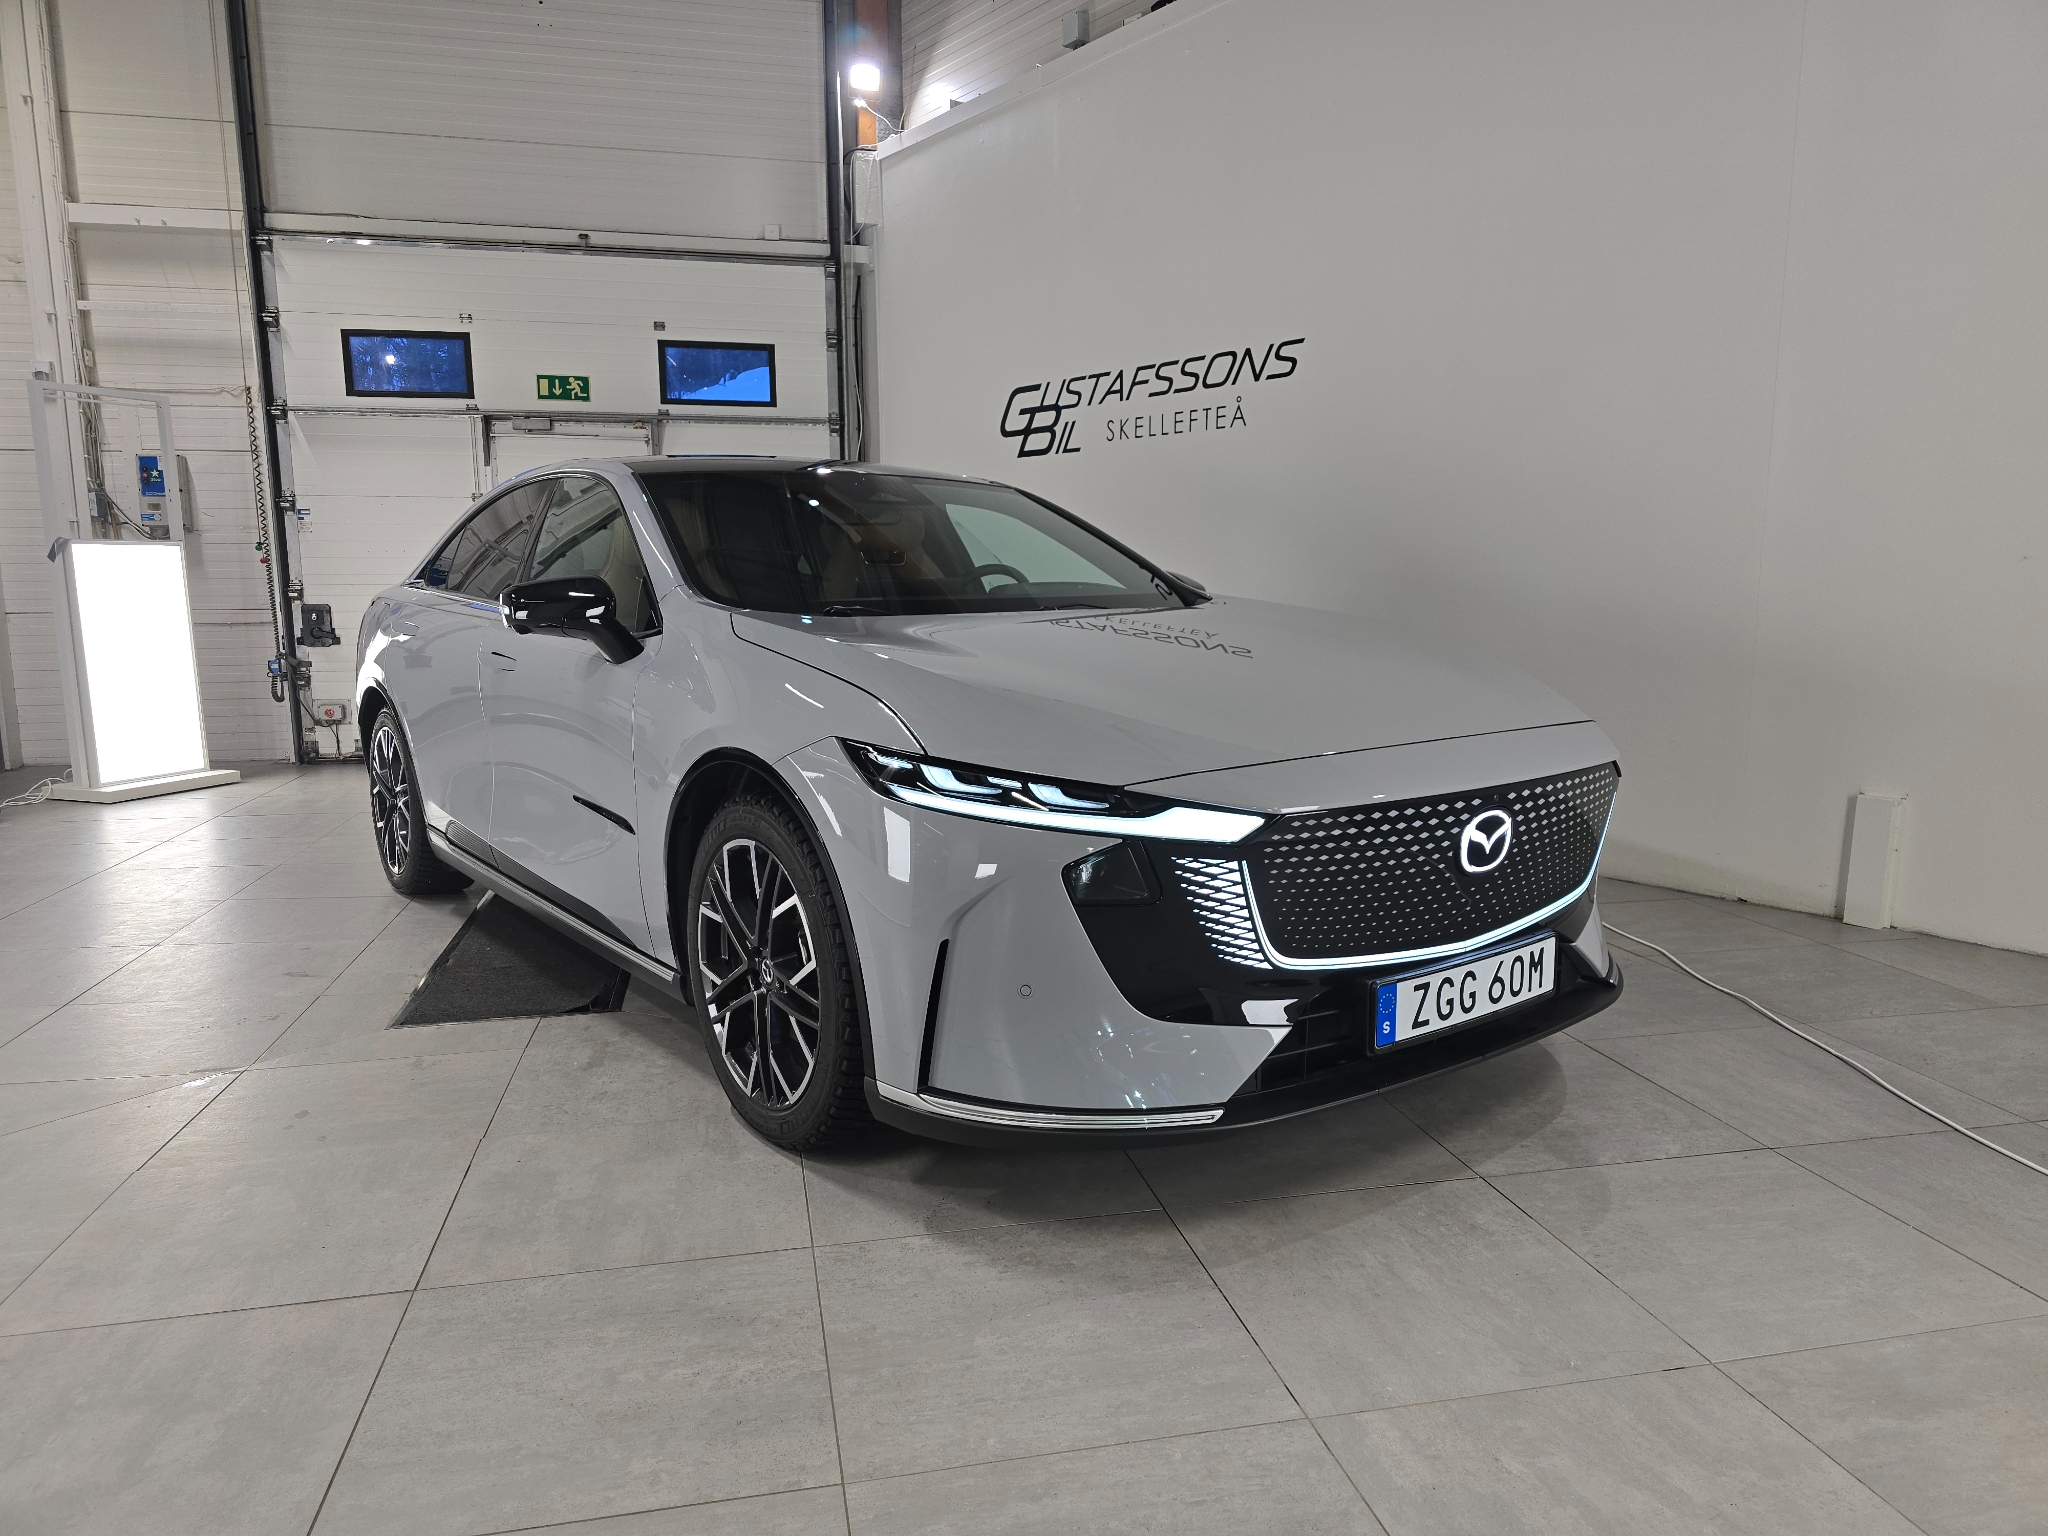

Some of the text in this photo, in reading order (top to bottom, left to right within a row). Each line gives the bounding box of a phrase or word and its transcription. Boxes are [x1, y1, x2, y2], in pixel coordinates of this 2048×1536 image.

[1000, 338, 1305, 438] GUSTAFSSONS
[1017, 402, 1081, 458] BIL
[1106, 396, 1247, 441] SKELLEFTEÅ
[1411, 946, 1545, 1030] ZGG 60M
[1382, 1021, 1390, 1034] S
